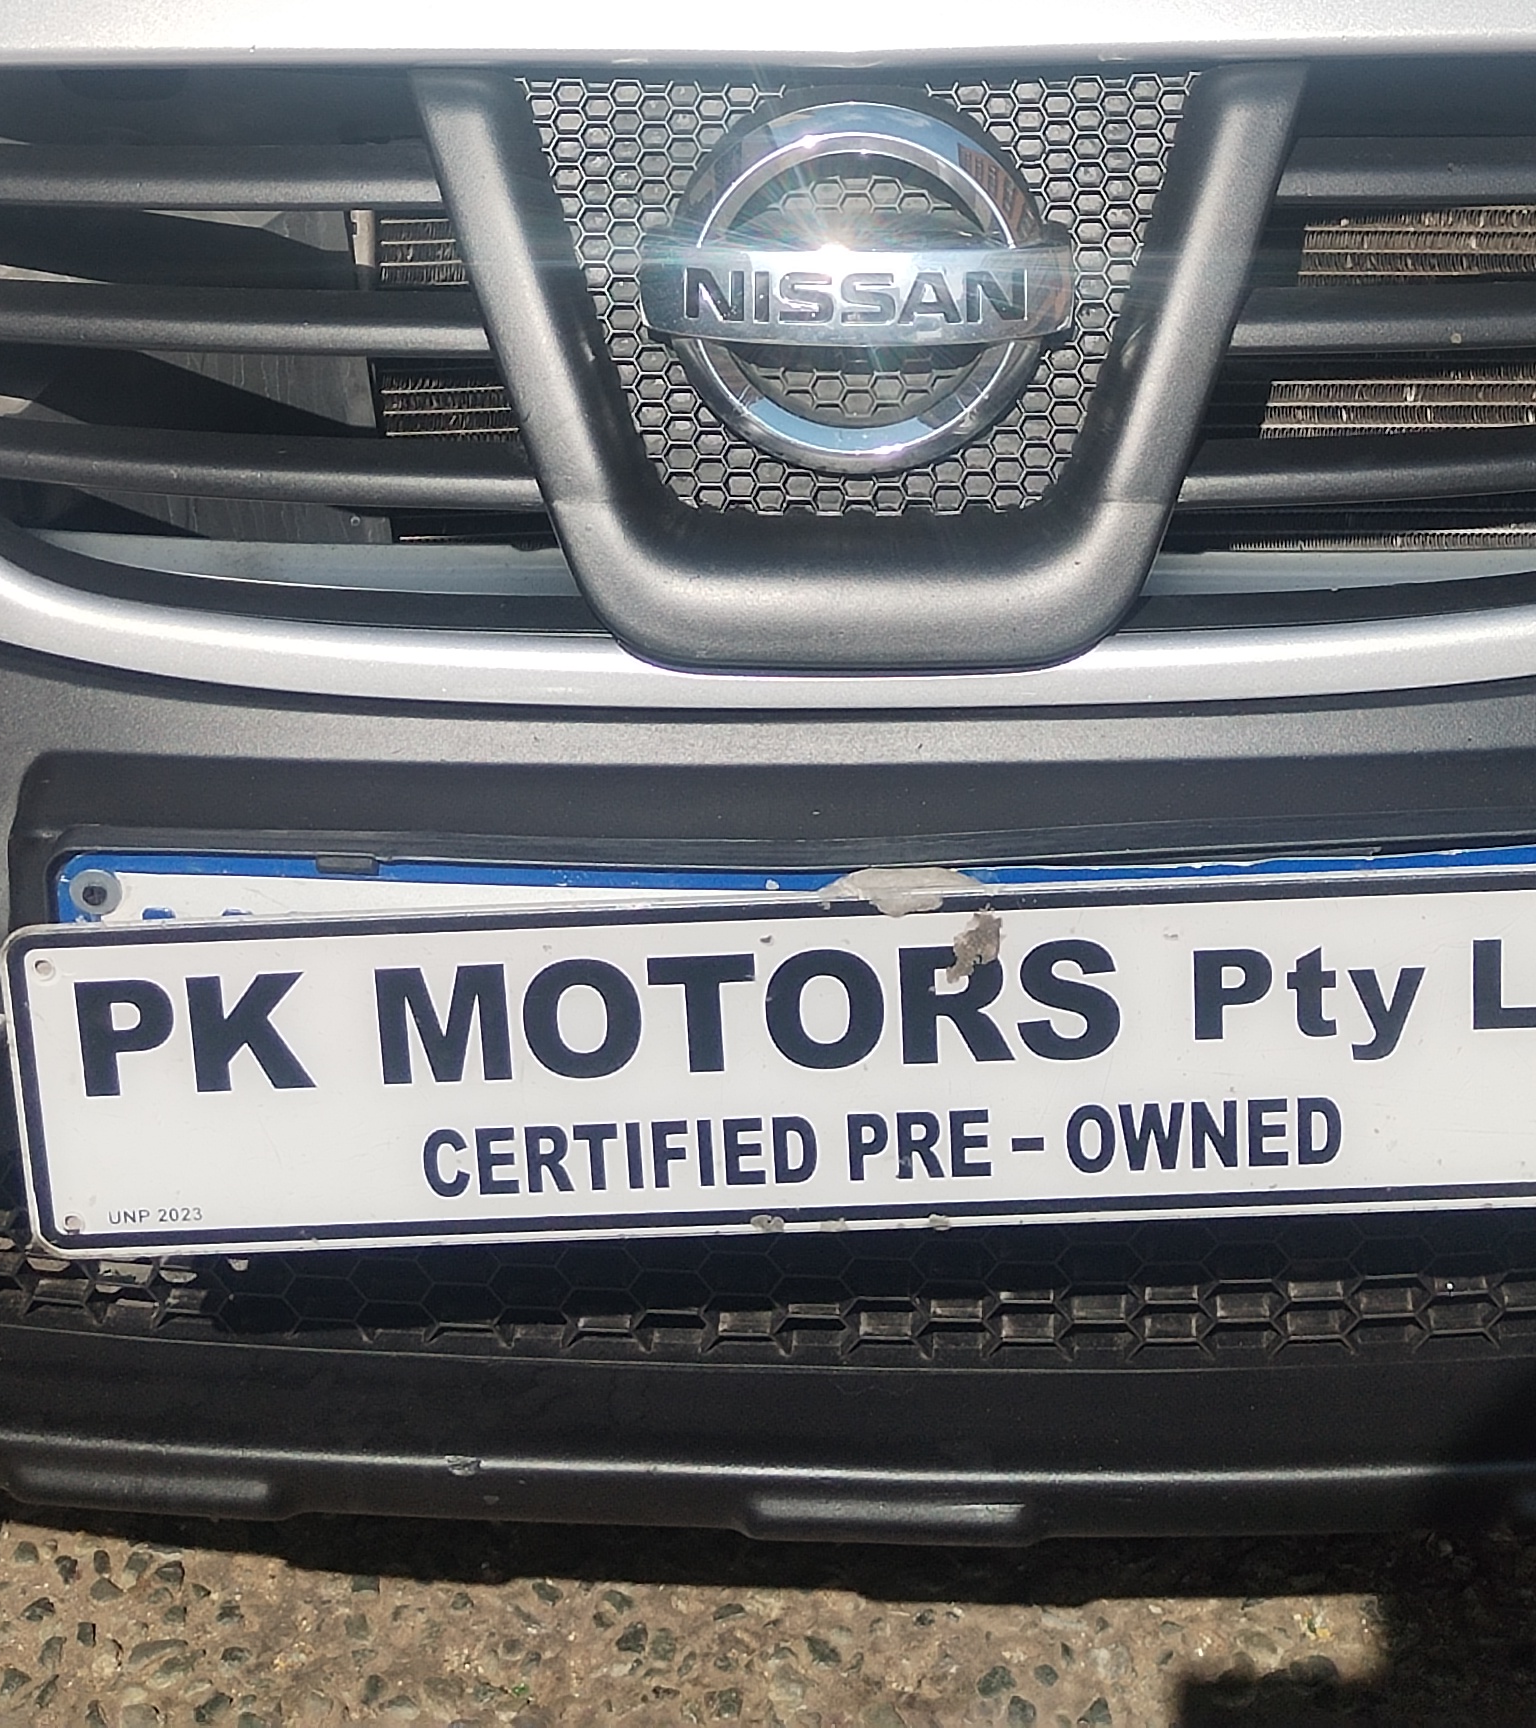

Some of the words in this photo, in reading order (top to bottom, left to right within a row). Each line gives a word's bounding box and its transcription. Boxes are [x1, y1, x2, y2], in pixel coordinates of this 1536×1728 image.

[681, 265, 1030, 326] NISSAN
[73, 971, 317, 1097] PK
[374, 939, 1121, 1085] MOTORS
[1193, 947, 1426, 1061] Pty
[423, 1116, 818, 1198] CERTIFIED
[846, 1109, 992, 1181] PRE
[1066, 1097, 1342, 1174] OWNED
[108, 1209, 150, 1225] UNP
[158, 1207, 203, 1223] 2023
